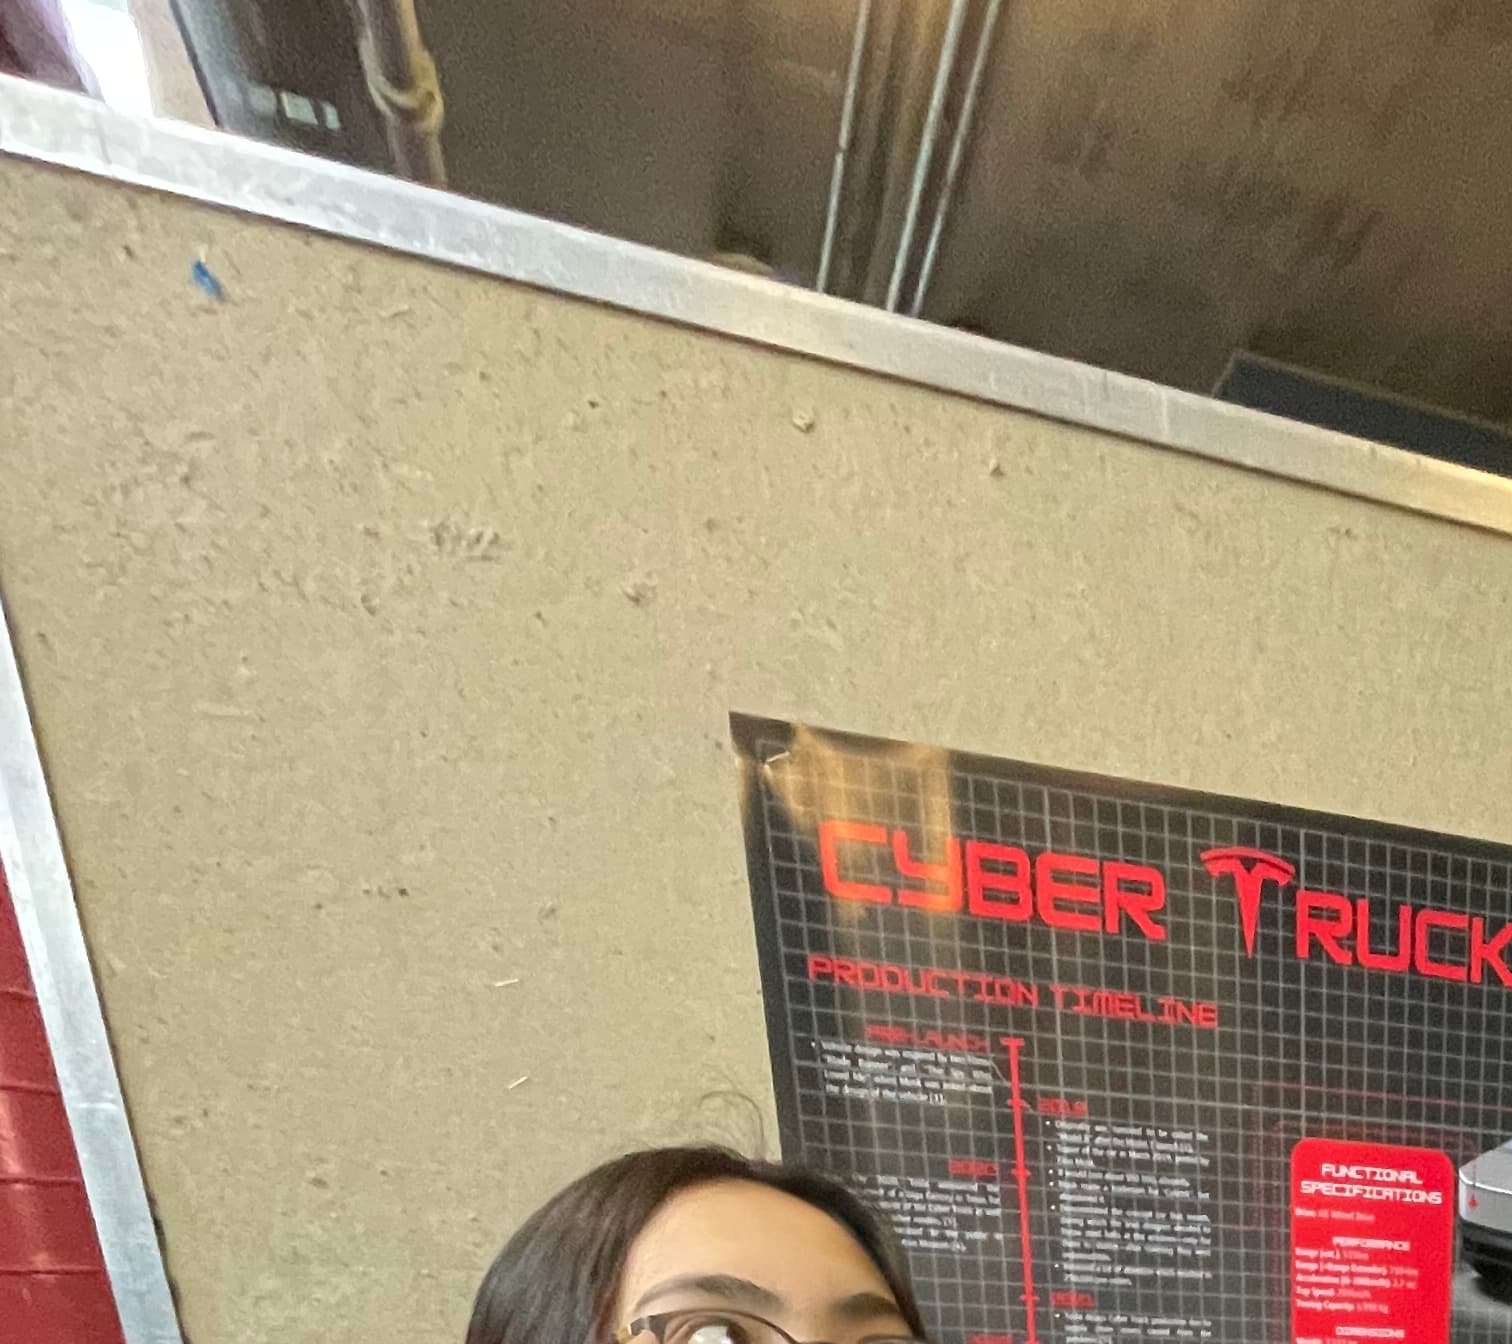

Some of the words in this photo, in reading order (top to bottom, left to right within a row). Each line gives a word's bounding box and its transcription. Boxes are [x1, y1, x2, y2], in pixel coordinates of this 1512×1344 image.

[818, 819, 1165, 941] CYBER
[807, 953, 1038, 1009] PRODUCTION
[1050, 984, 1218, 1029] TIMELINE
[1300, 1180, 1443, 1205] SPECIFICATIONS
[1320, 1163, 1423, 1185] FUNCTIONAL
